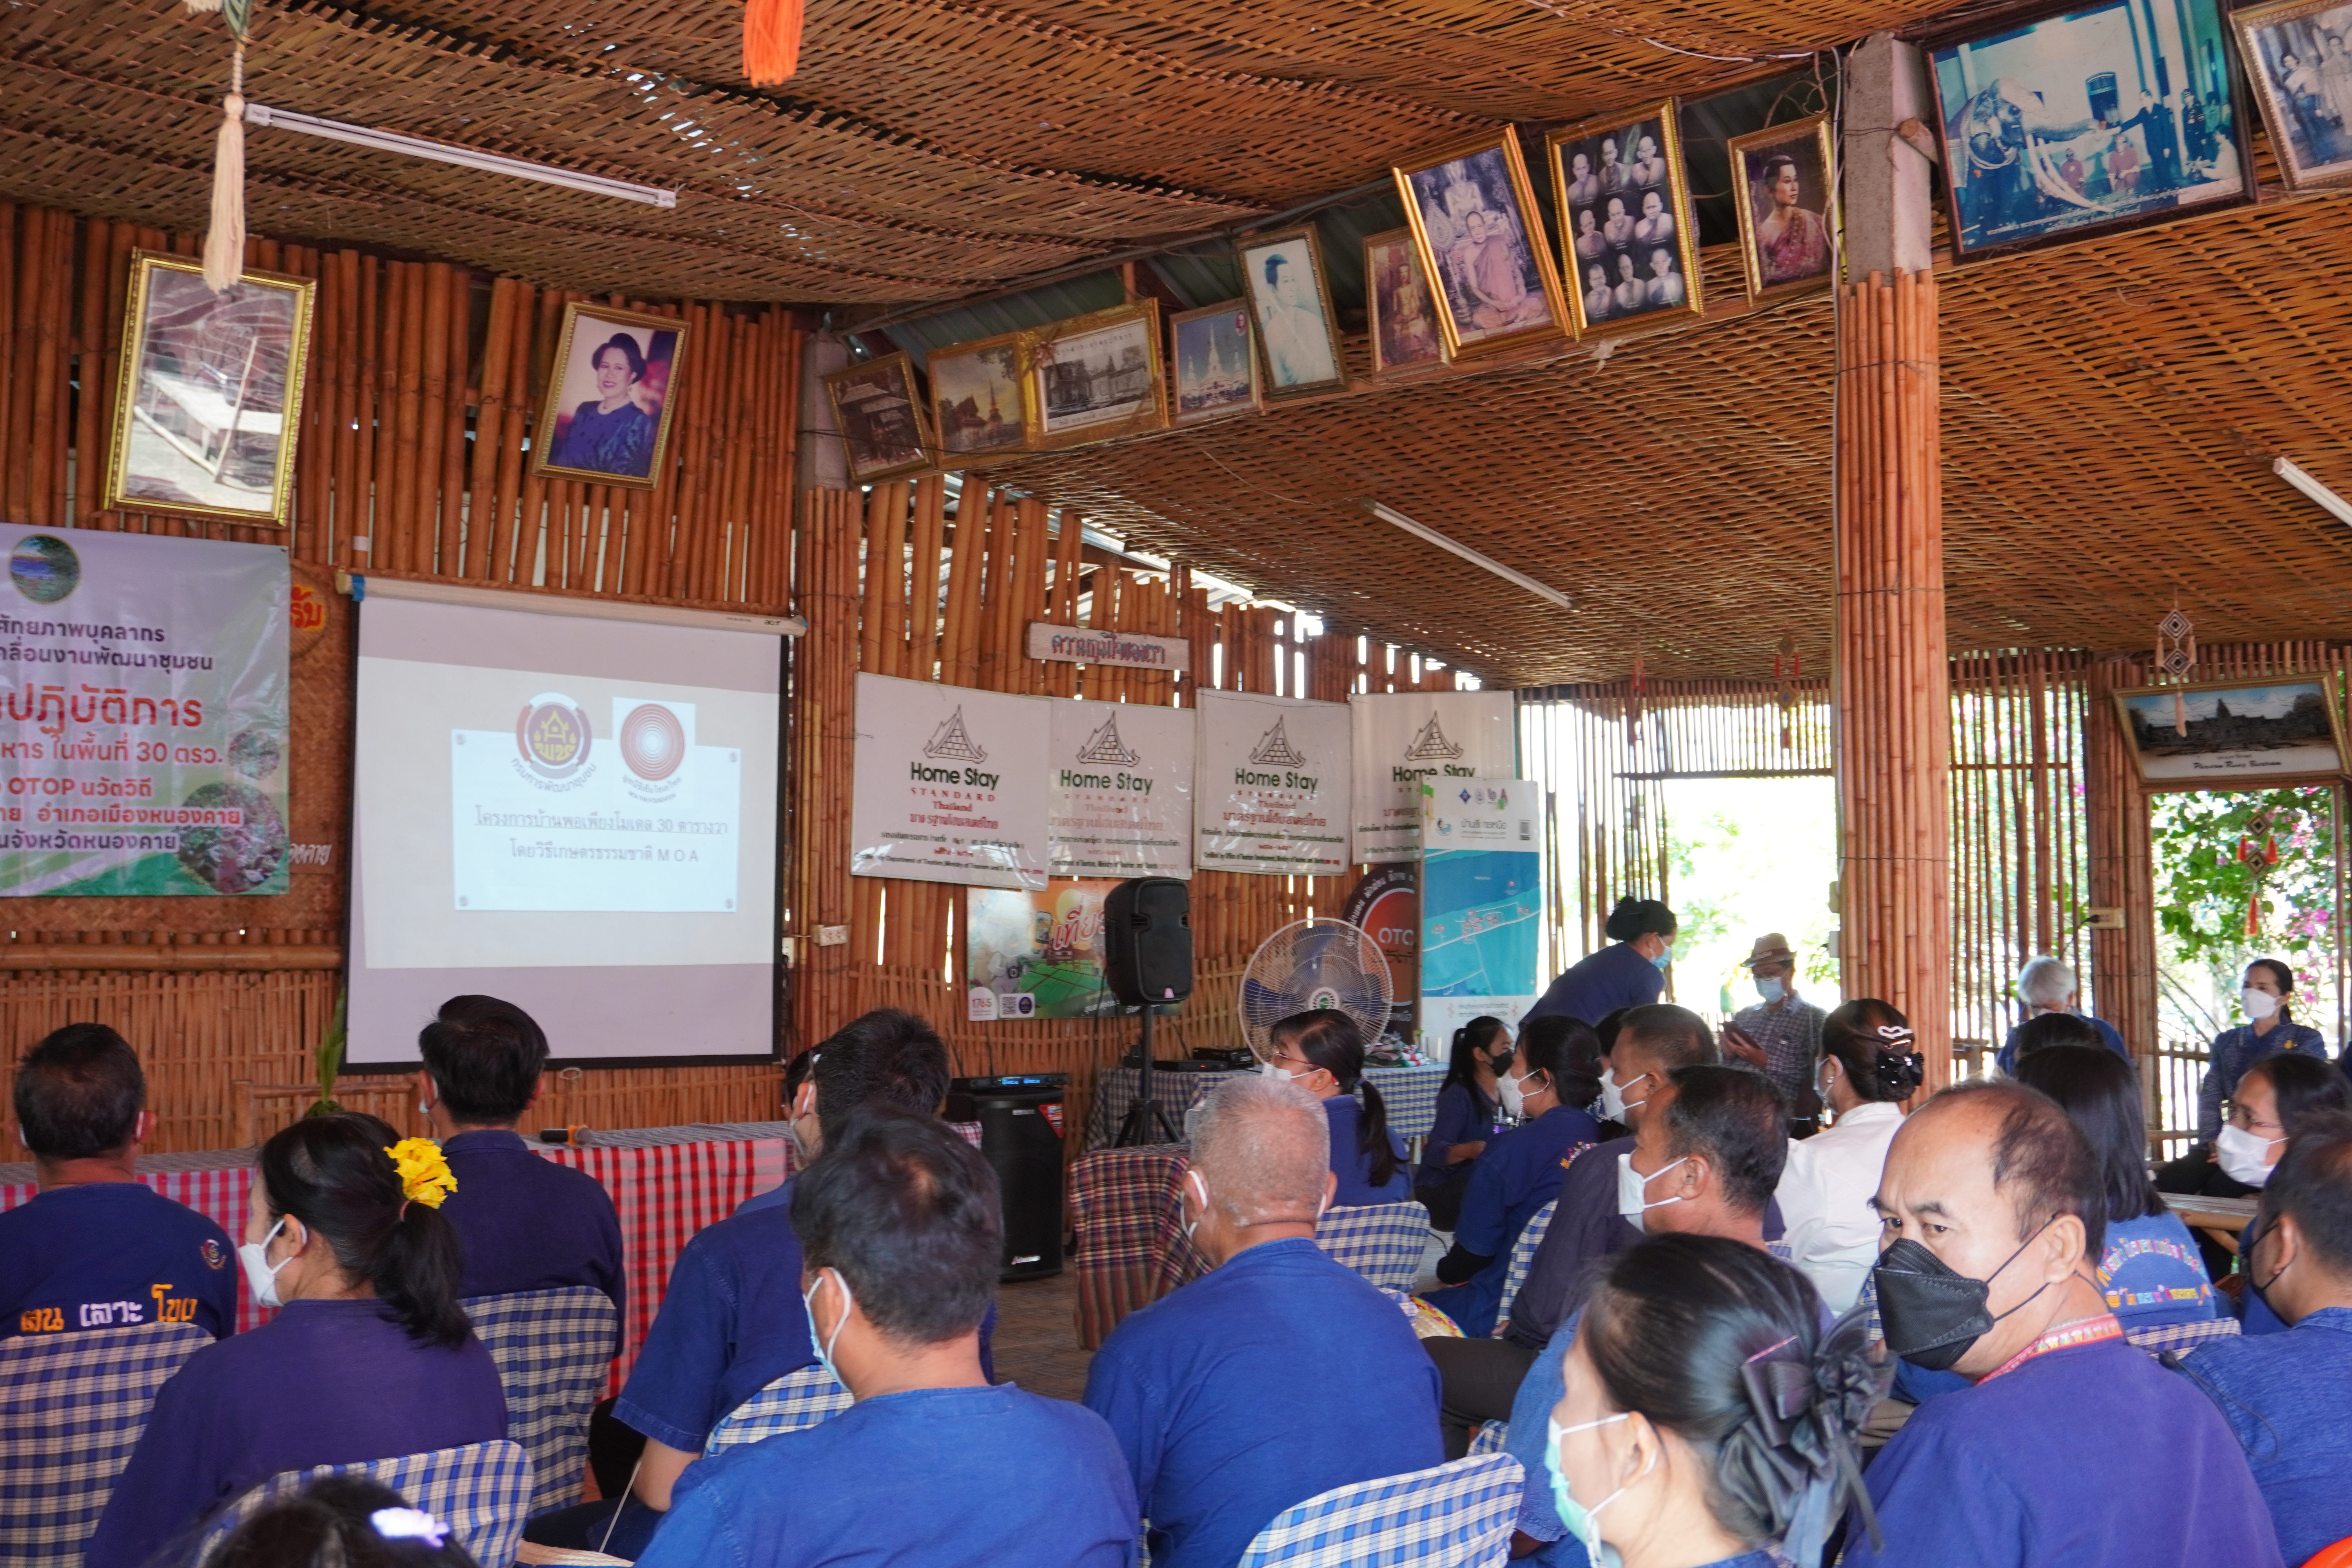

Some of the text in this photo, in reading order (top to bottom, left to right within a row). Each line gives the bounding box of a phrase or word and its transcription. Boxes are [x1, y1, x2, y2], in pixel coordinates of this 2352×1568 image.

[0, 683, 202, 734] ปฏิบัติการ
[137, 742, 167, 762] 30
[175, 747, 223, 764] ตรว.
[911, 762, 1000, 790] Home Stay
[1060, 769, 1154, 795] Home Stay
[1235, 768, 1318, 793] Home Stay
[1393, 766, 1437, 782] Home
[8, 777, 75, 795] OTOP
[911, 787, 996, 802] STANDARD
[37, 802, 241, 824] อำเภอเมืองหนองคาย
[933, 801, 973, 811] Thailand
[657, 819, 673, 832] 30
[80, 1300, 143, 1327] เลาะ
